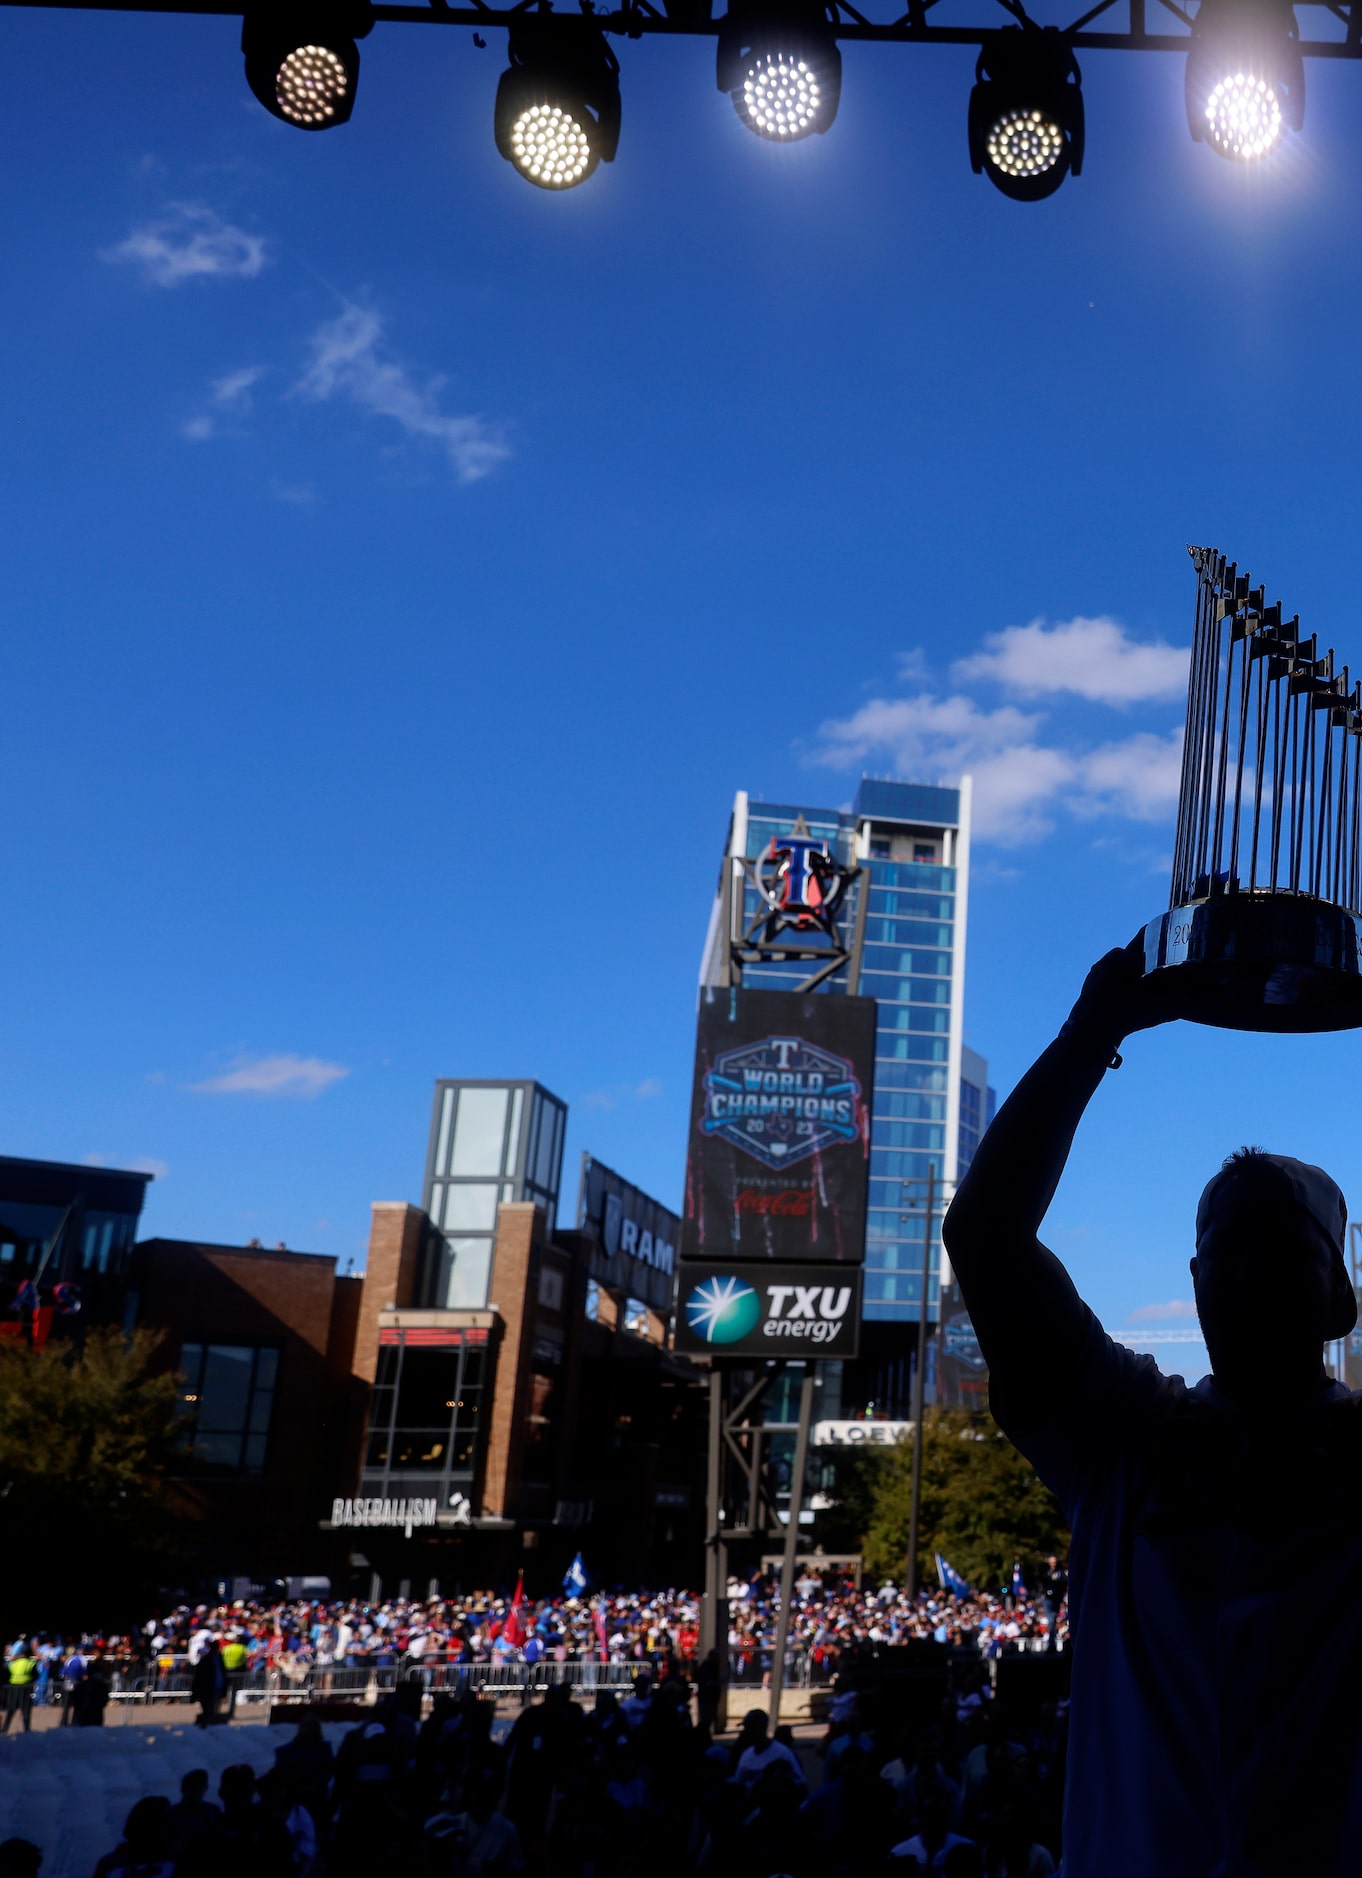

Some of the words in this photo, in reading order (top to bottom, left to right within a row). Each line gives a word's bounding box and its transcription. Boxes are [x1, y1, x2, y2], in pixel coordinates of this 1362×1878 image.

[772, 1041, 798, 1069] T
[744, 1069, 823, 1093] WORLD
[711, 1093, 850, 1123] CHAMPIONS
[746, 1119, 764, 1133] 20
[620, 1217, 675, 1277] RAM
[767, 1285, 852, 1320] TXU
[763, 1320, 843, 1343] energy
[331, 1498, 438, 1538] BASEBALLISM
